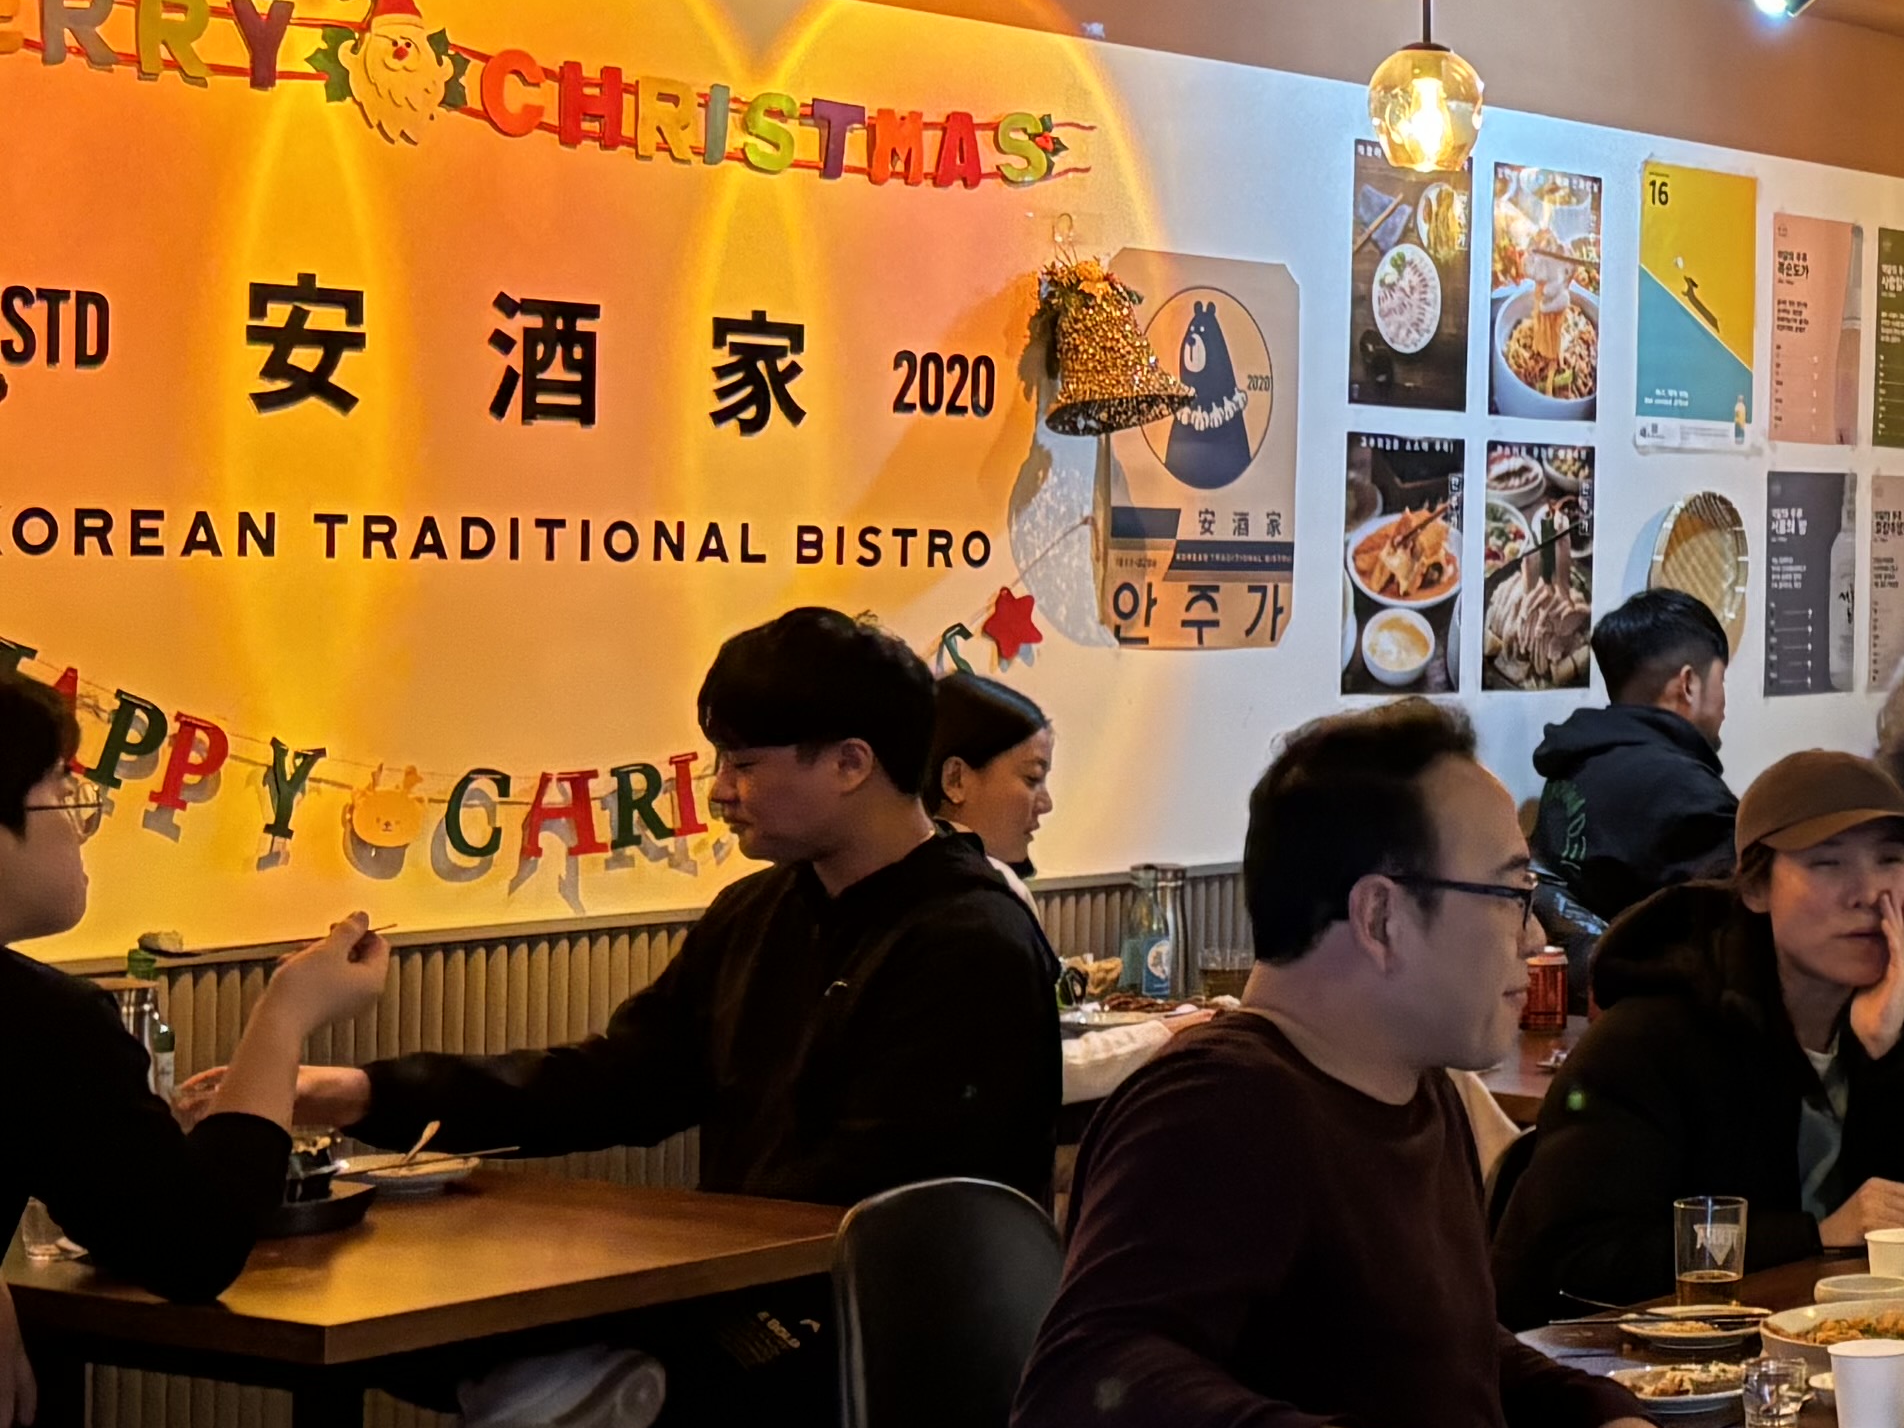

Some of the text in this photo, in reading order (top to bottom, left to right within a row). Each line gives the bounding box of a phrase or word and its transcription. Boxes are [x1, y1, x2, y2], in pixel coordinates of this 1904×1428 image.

[480, 47, 1055, 189] CHRISTMAS
[1647, 179, 1670, 206] 16
[0, 284, 110, 370] STD
[245, 273, 807, 437] 安酒家
[890, 349, 995, 418] 2020
[1247, 373, 1271, 393] 2020
[0, 506, 992, 569] OREAN TRADITIONAL BISTRO
[1198, 508, 1282, 538] 安酒家
[1111, 580, 1285, 648] 안주가
